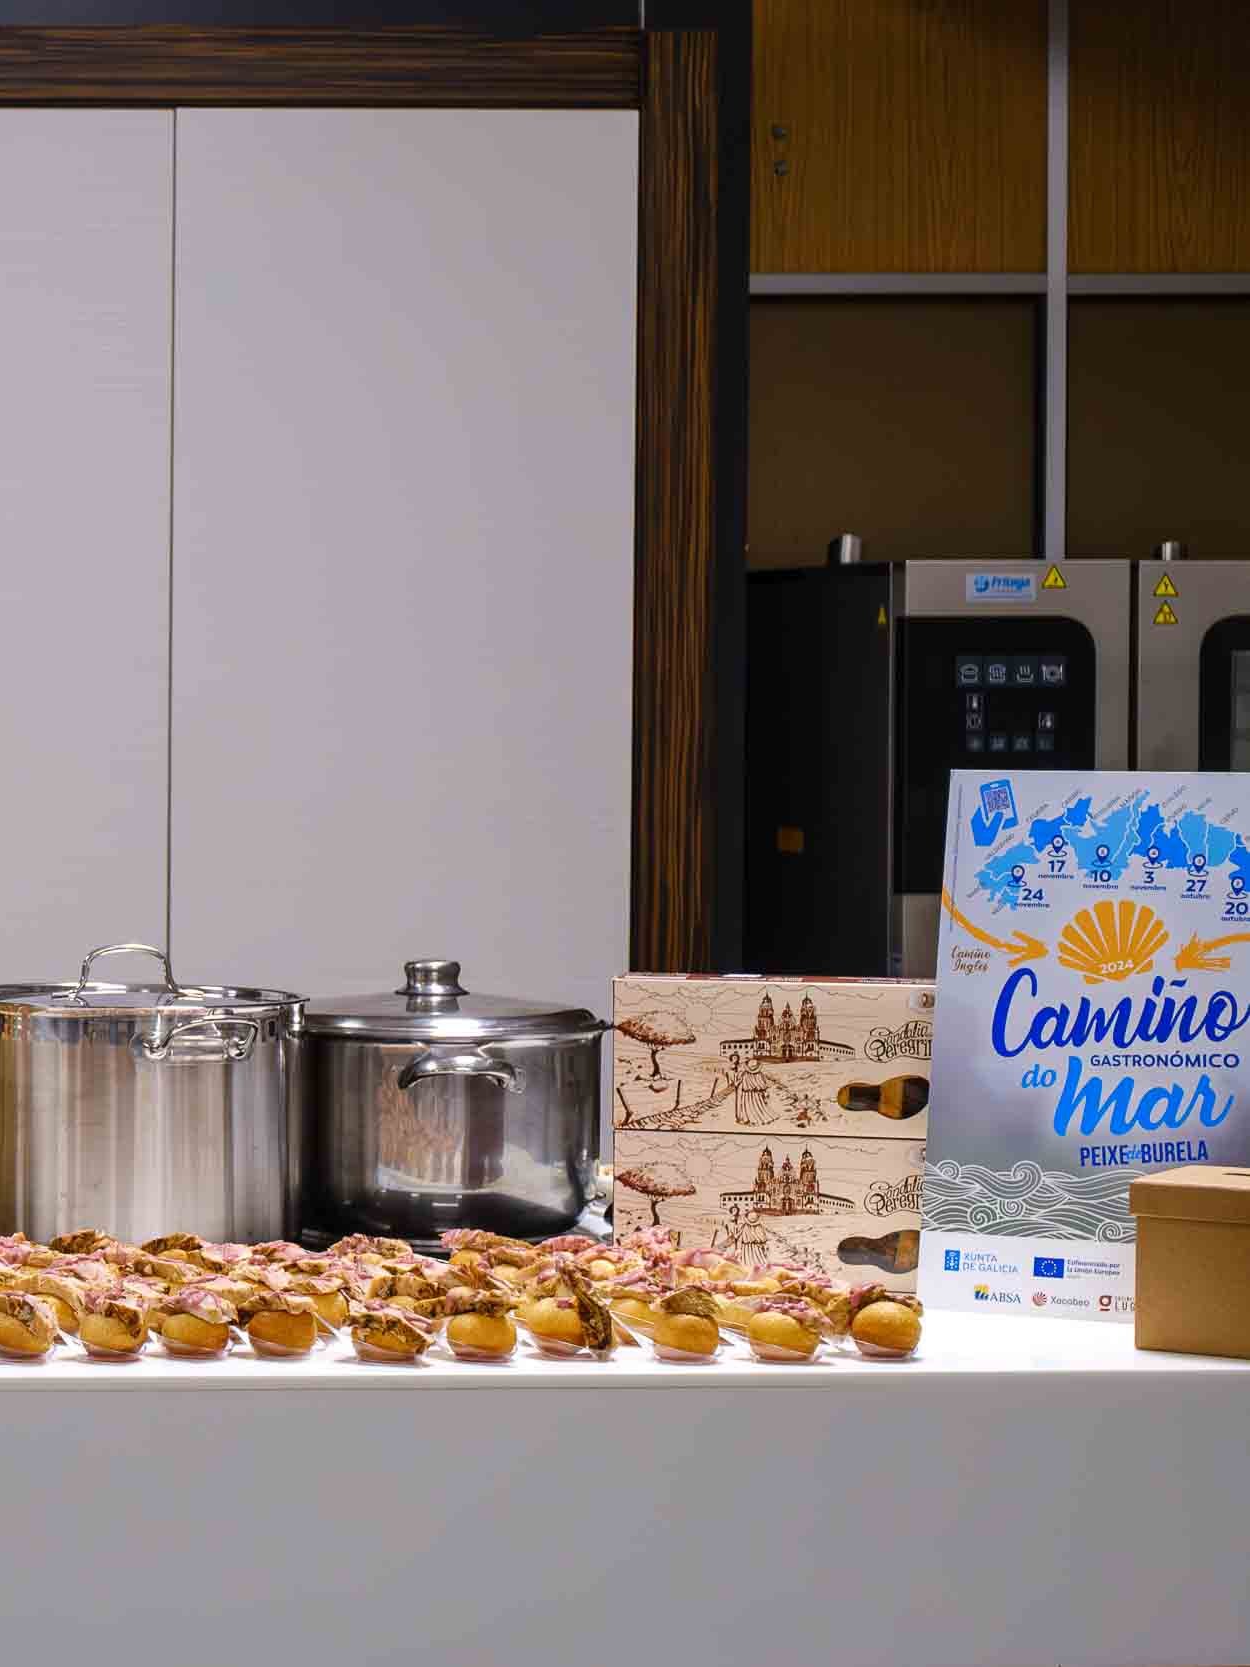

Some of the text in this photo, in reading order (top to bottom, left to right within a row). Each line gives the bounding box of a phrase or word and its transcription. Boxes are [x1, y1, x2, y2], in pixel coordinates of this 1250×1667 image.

[1048, 860, 1066, 873] 17
[1091, 869, 1112, 883] 10
[1143, 871, 1155, 884] 3
[1185, 879, 1207, 892] 27
[1021, 888, 1044, 901] 24
[1224, 901, 1249, 915] 20
[1100, 959, 1134, 974] 2024
[991, 967, 1250, 1058] Camiño
[1090, 1050, 1240, 1068] GASTRONÓMICO
[1021, 1063, 1057, 1089] do
[1080, 1145, 1128, 1167] PEIXE
[1141, 1140, 1209, 1162] BURELA
[963, 1252, 998, 1263] XUNTA
[962, 1262, 1019, 1273] DE GALICIA
[989, 1292, 1021, 1304] ABSA
[1050, 1295, 1090, 1307] Xacobeo
